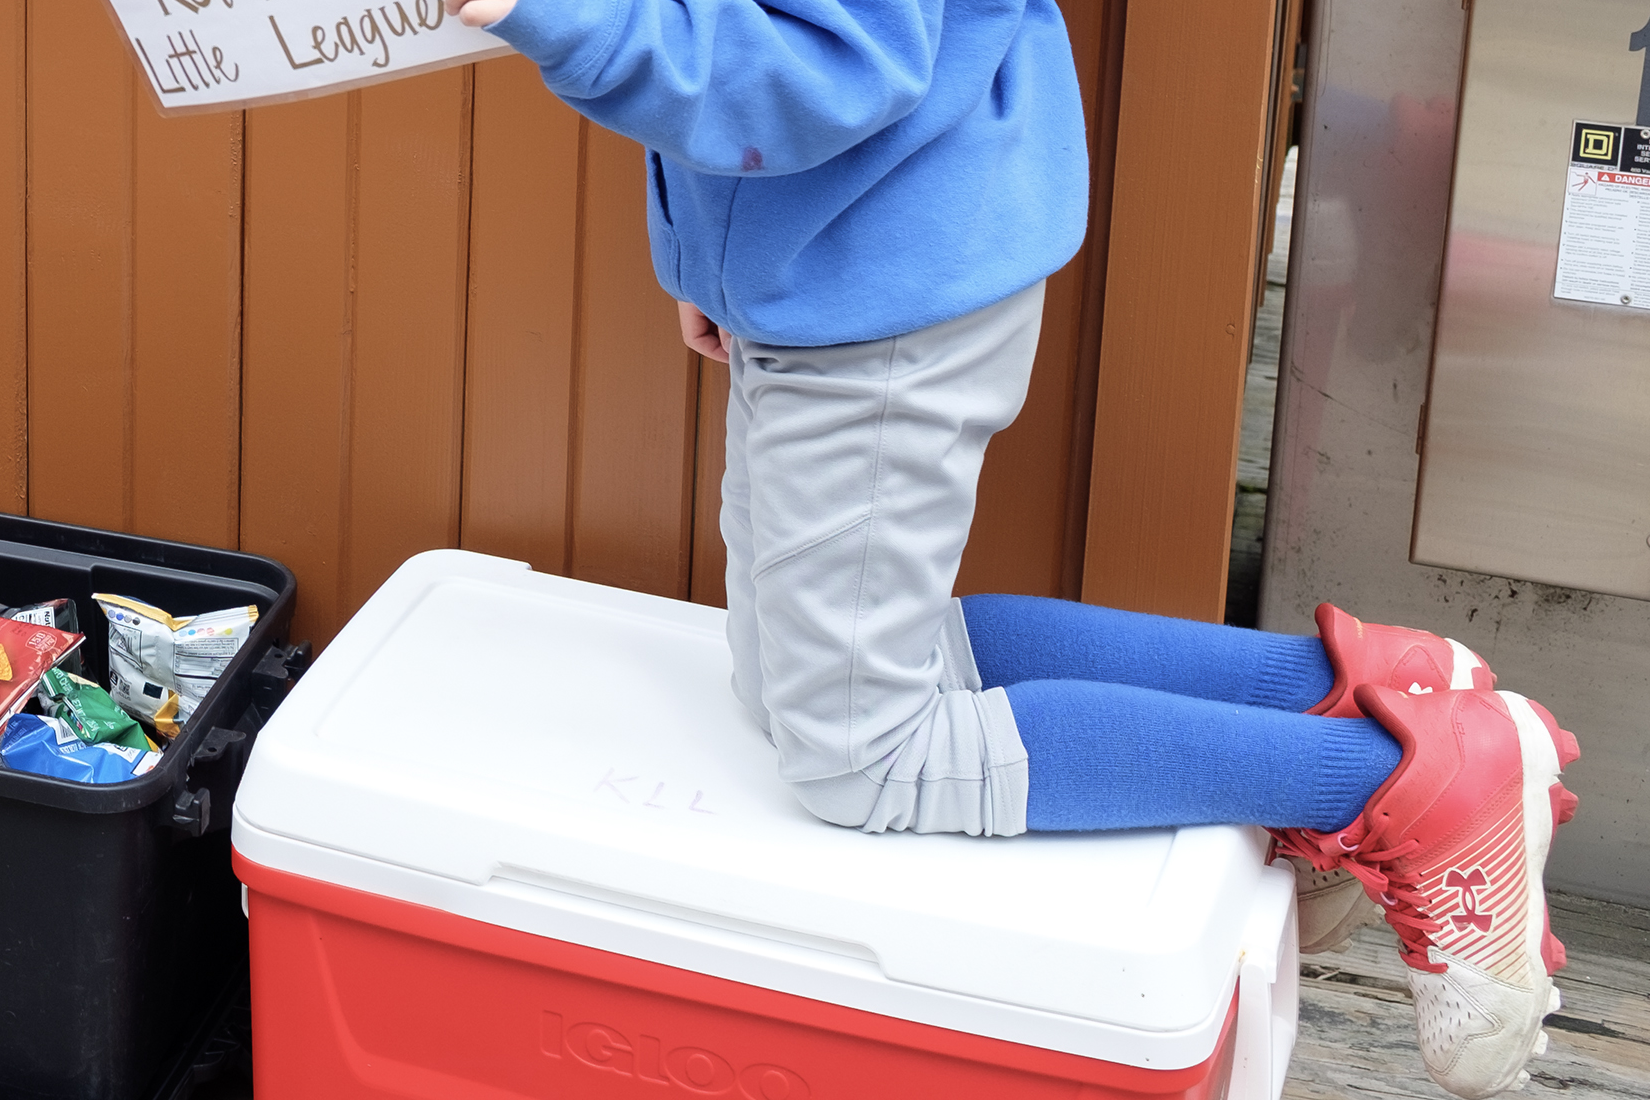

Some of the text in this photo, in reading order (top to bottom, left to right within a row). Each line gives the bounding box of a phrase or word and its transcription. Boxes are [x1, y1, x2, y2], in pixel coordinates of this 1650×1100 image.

[135, 28, 240, 95] Little
[592, 766, 720, 816] KLL
[539, 1008, 813, 1100] IGLOO
